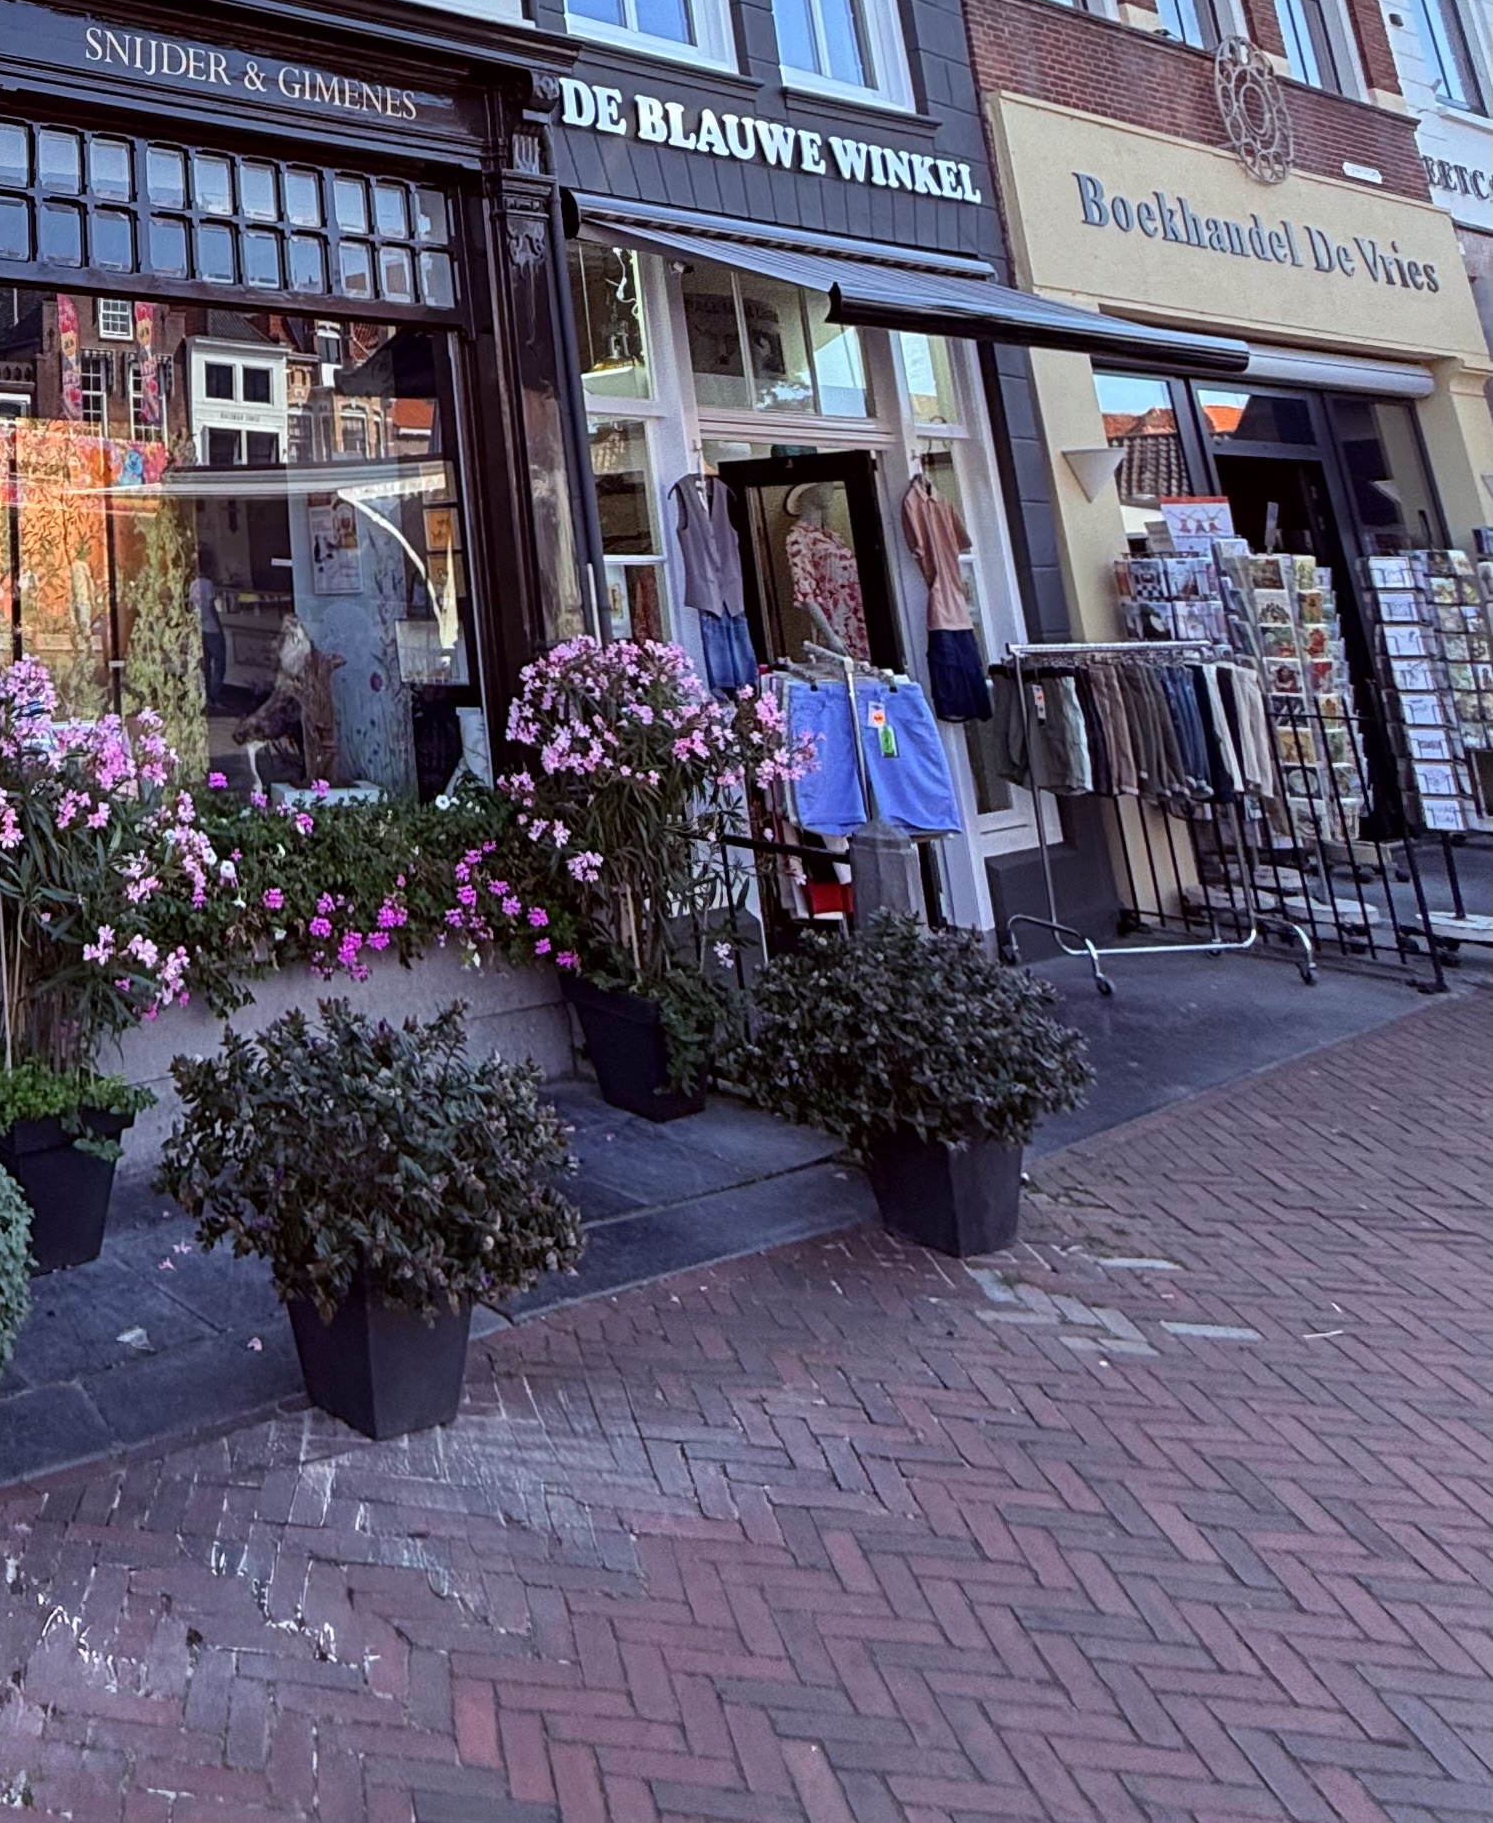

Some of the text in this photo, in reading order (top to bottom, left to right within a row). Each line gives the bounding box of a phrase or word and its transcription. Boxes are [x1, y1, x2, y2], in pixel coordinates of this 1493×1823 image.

[85, 27, 417, 120] SNIJDER & GIMENES
[559, 77, 982, 204] DE BLAUWE WINKEL
[1422, 154, 1492, 201] EETC
[1072, 172, 1440, 293] Boekhandel De Vries
